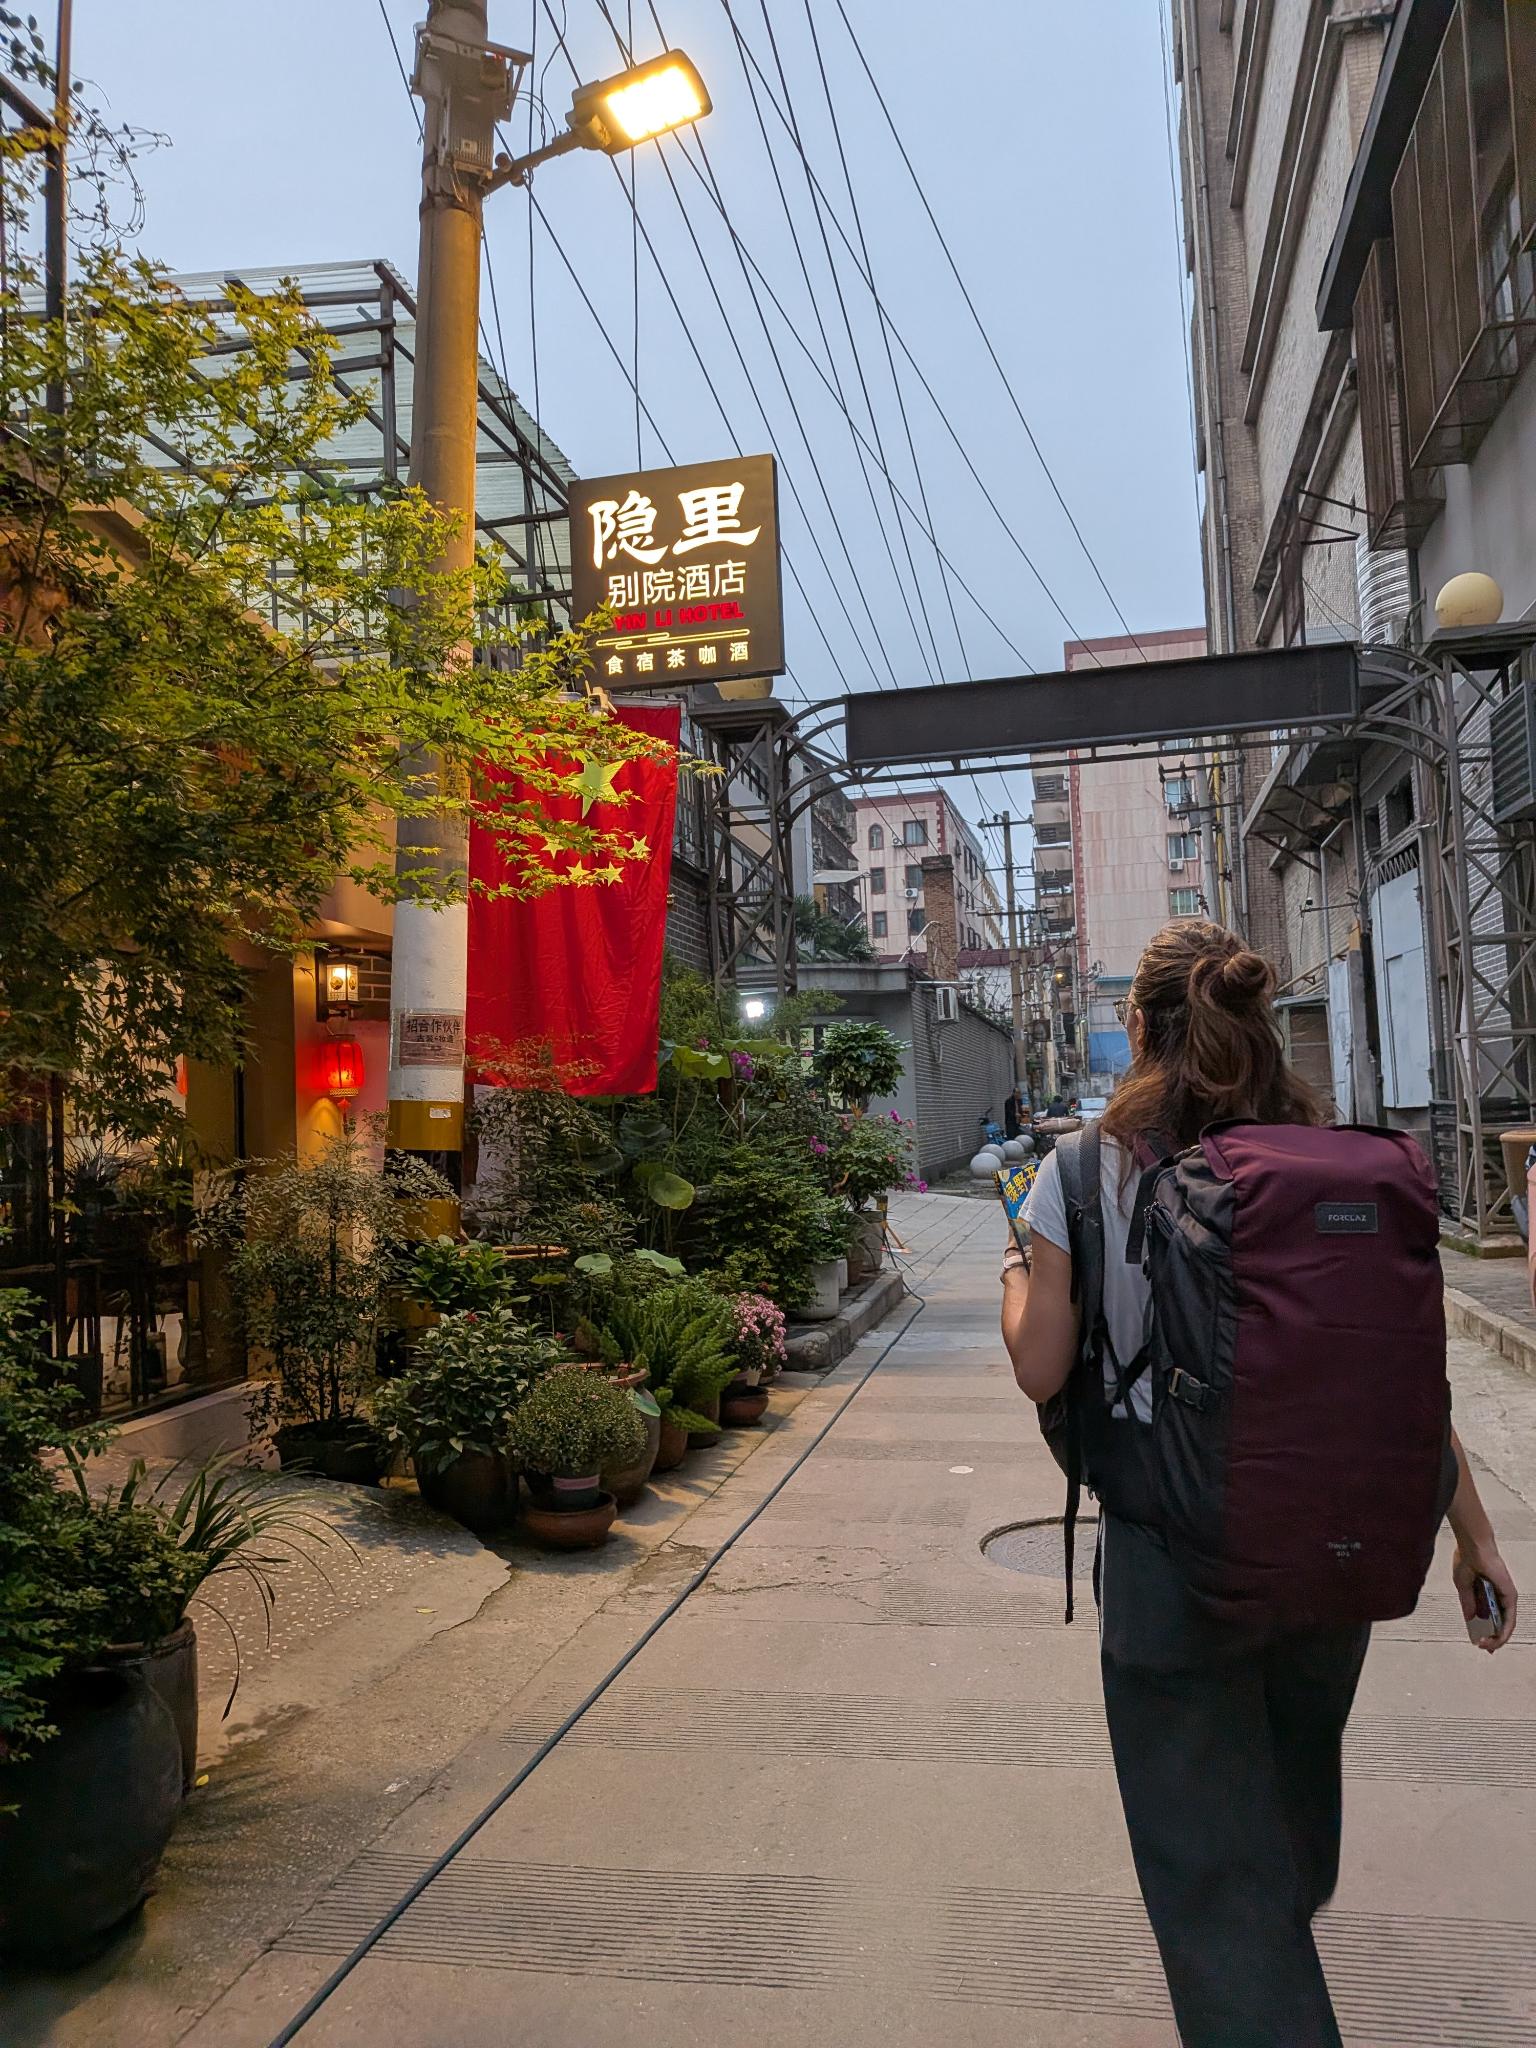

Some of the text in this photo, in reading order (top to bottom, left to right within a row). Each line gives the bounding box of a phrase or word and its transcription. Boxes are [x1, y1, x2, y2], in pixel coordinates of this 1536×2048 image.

[587, 481, 762, 570] 隐里
[607, 559, 747, 609] 别院酒店
[613, 601, 745, 632] YIN LI HOTEL
[605, 641, 749, 675] 食宿茶咖酒
[1327, 1214, 1367, 1222] FORCLAZ
